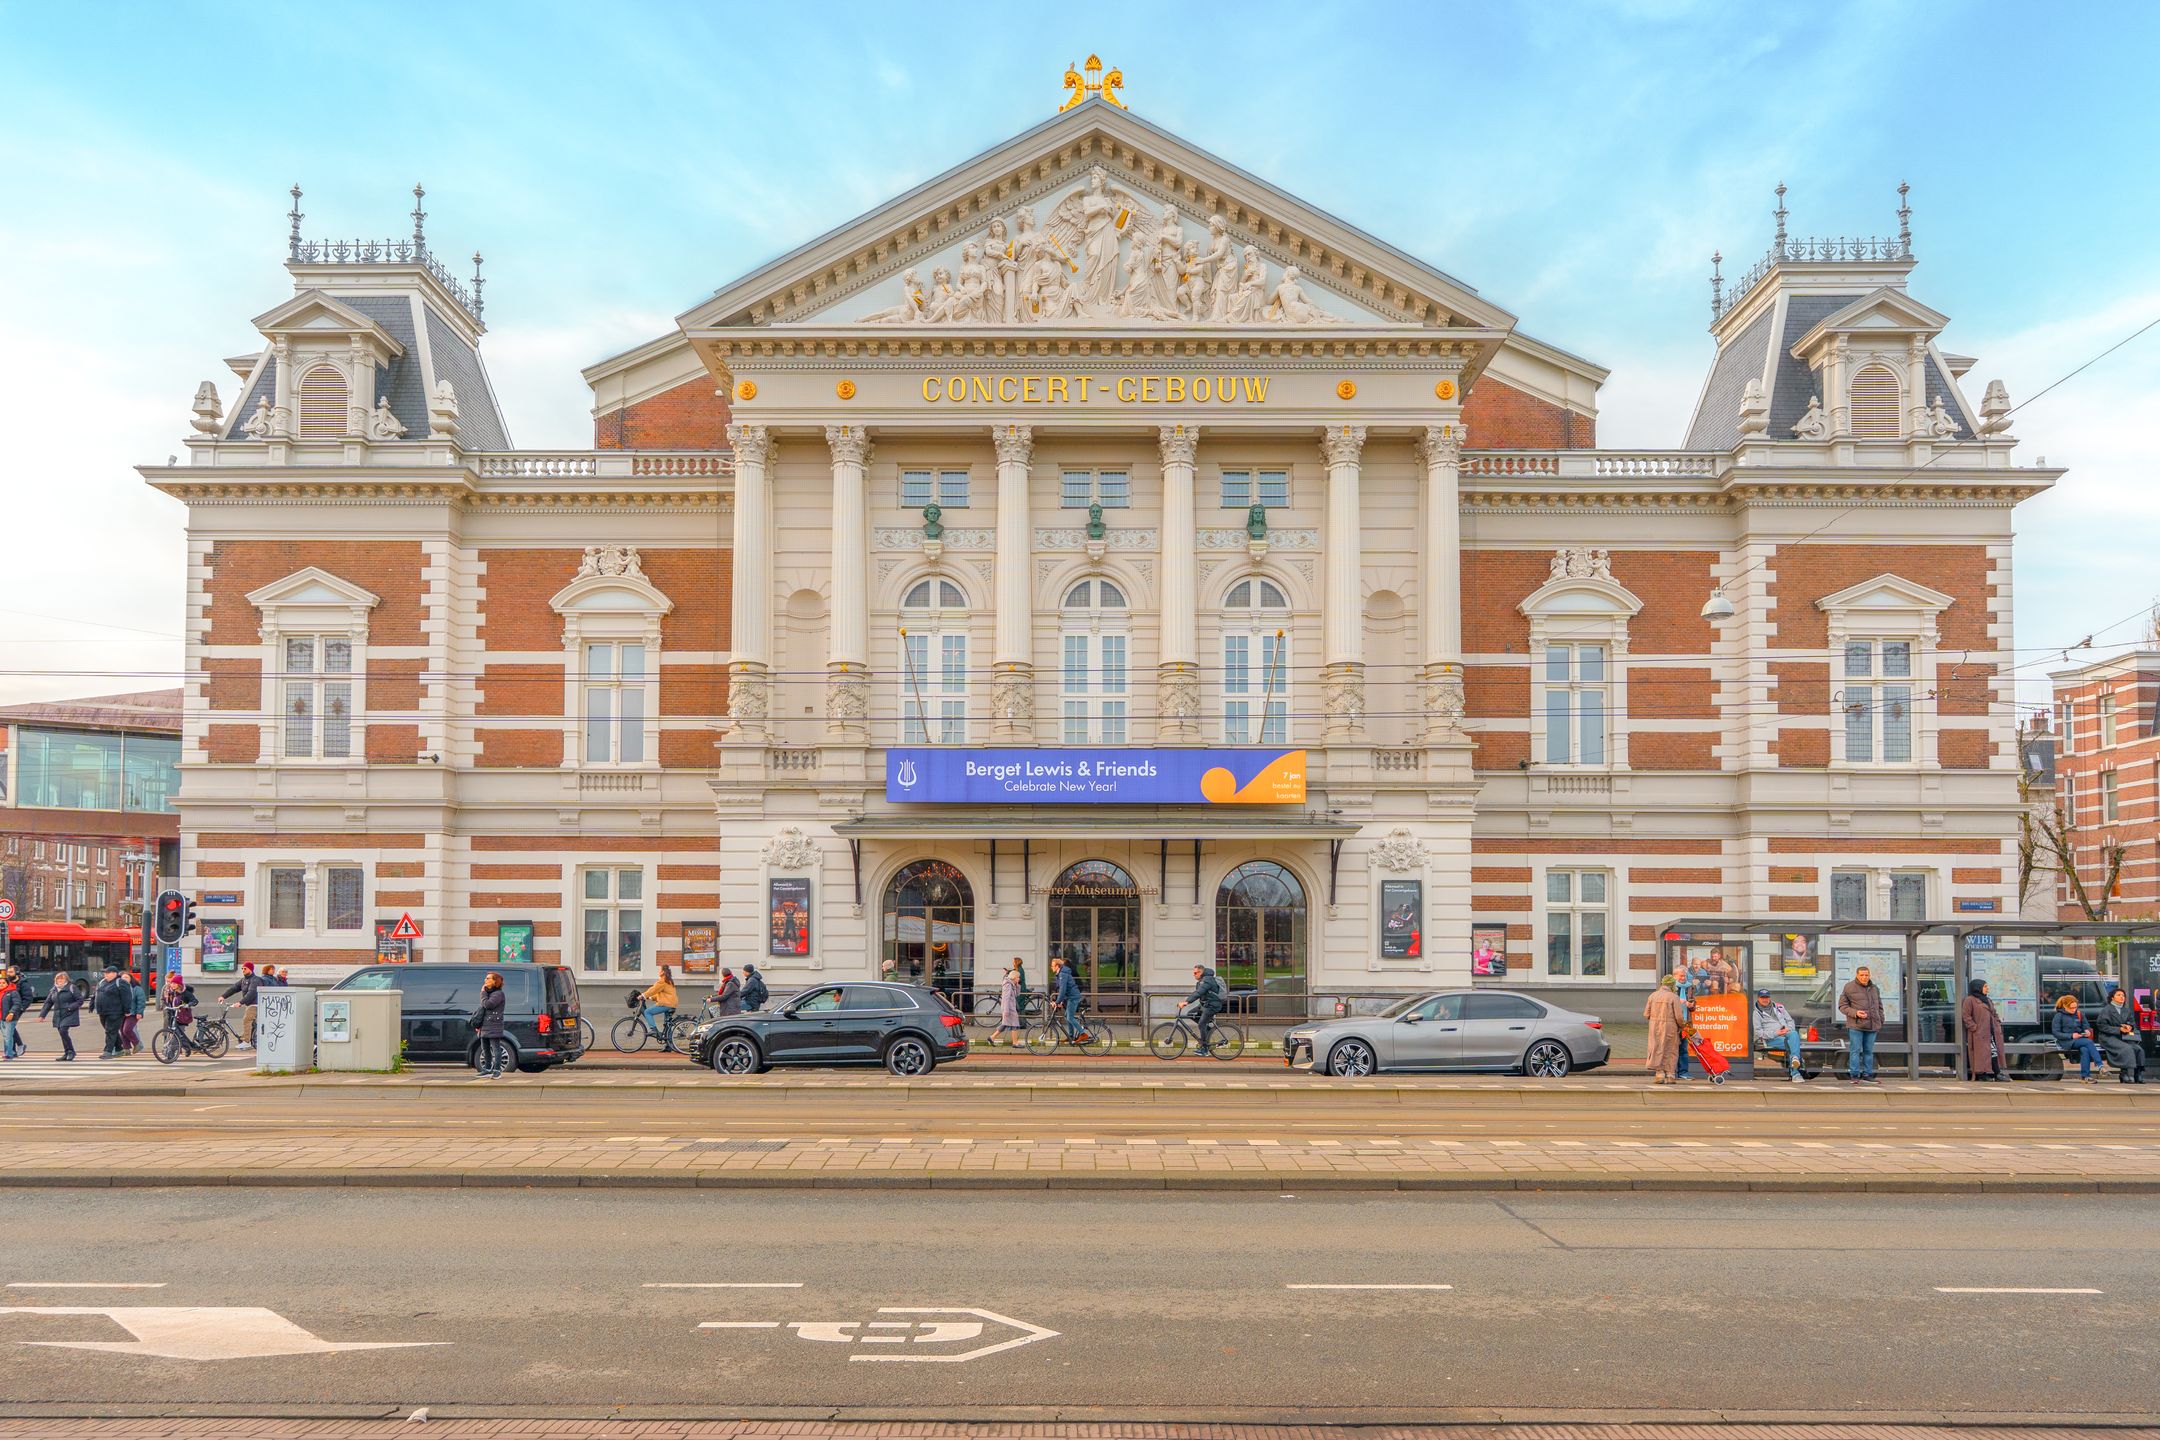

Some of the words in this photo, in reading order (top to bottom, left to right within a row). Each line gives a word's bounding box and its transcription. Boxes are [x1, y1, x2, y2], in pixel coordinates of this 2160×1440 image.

[921, 376, 1271, 402] CONCERT-GEBOUW
[966, 761, 1021, 780] Berget
[1026, 761, 1072, 776] Lewis
[1077, 761, 1091, 776] &
[1096, 760, 1157, 776] Friends
[1289, 772, 1301, 780] jan
[1004, 780, 1056, 792] Celebrate
[1059, 780, 1086, 792] New
[1088, 780, 1117, 792] Year!
[1075, 884, 1158, 898] Museumplein
[0, 905, 11, 913] 30
